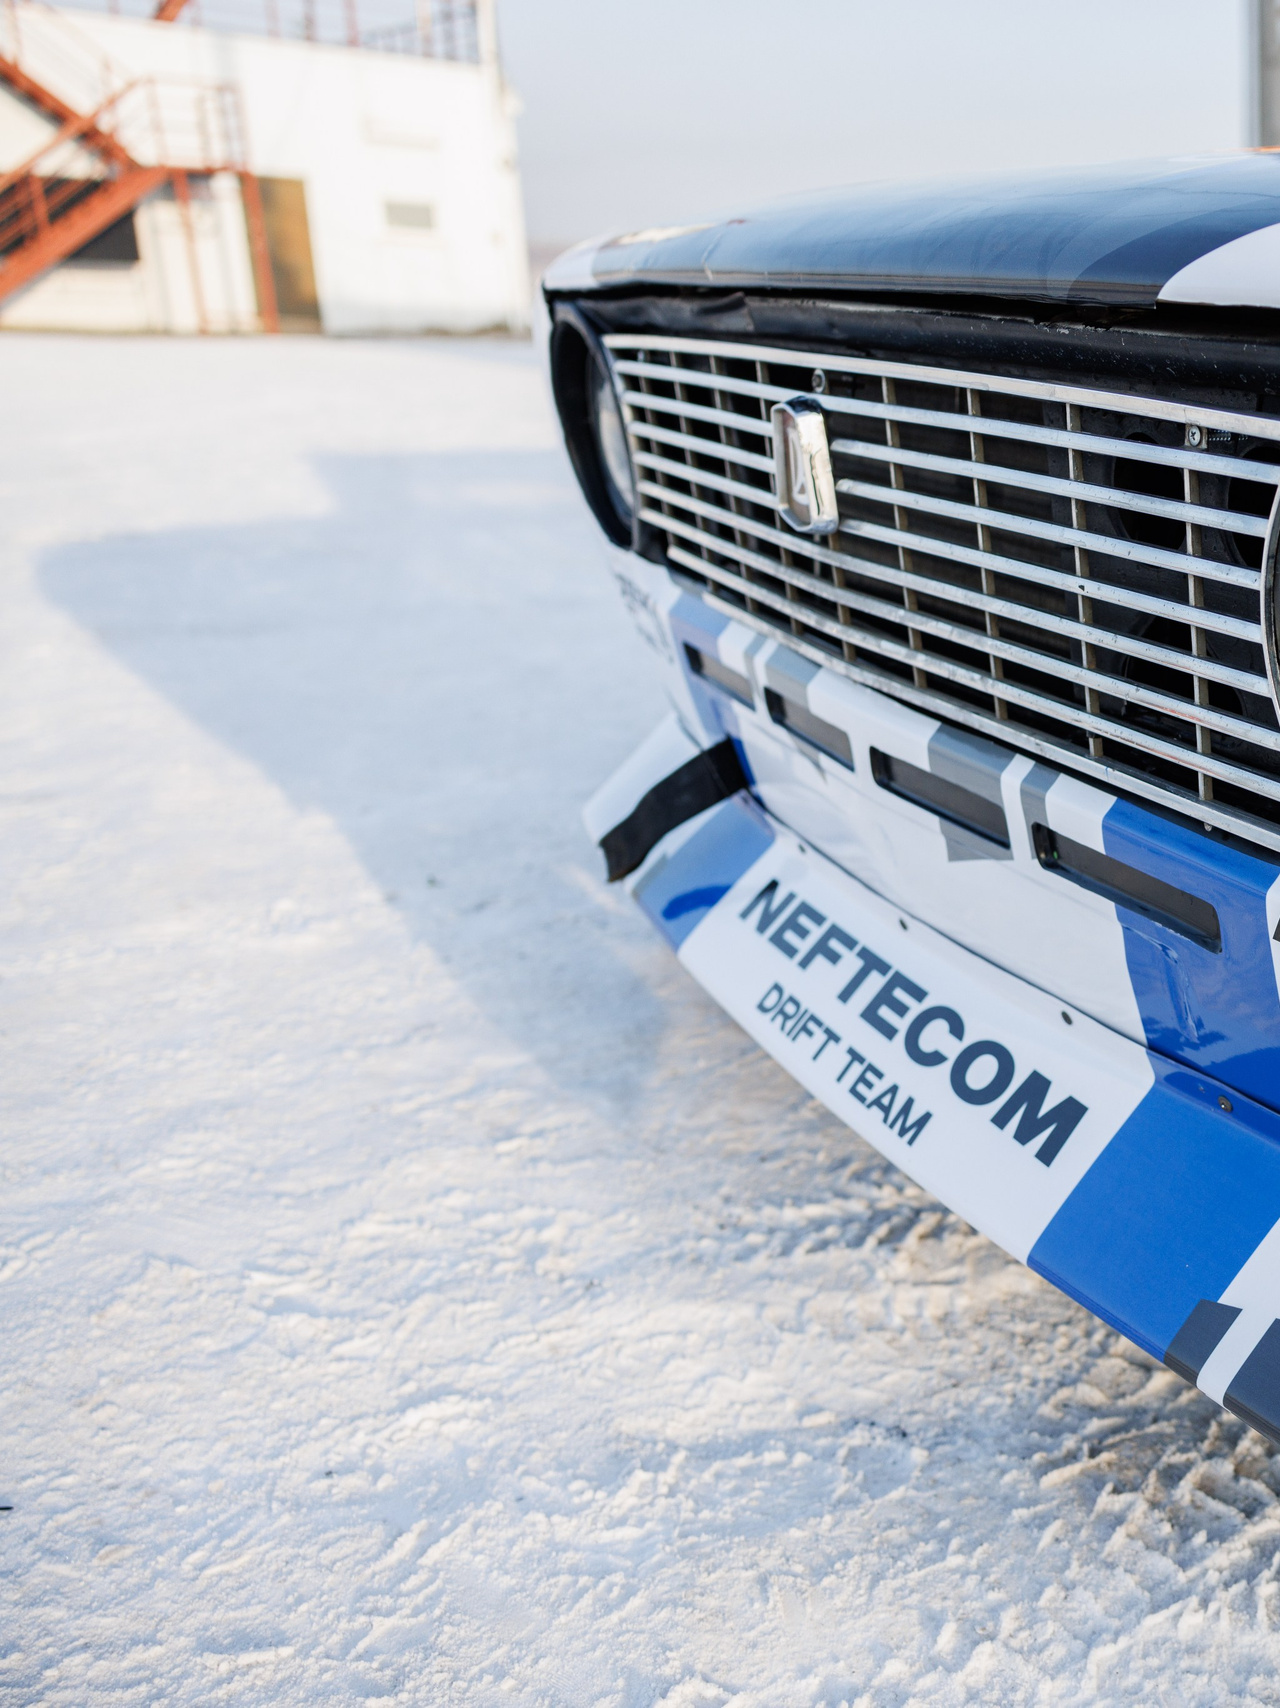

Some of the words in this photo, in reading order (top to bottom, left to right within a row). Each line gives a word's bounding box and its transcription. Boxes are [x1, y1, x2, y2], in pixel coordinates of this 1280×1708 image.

[738, 878, 1089, 1168] NEFTECOM
[756, 981, 842, 1062] DRIFT
[835, 1046, 933, 1147] TEAM
